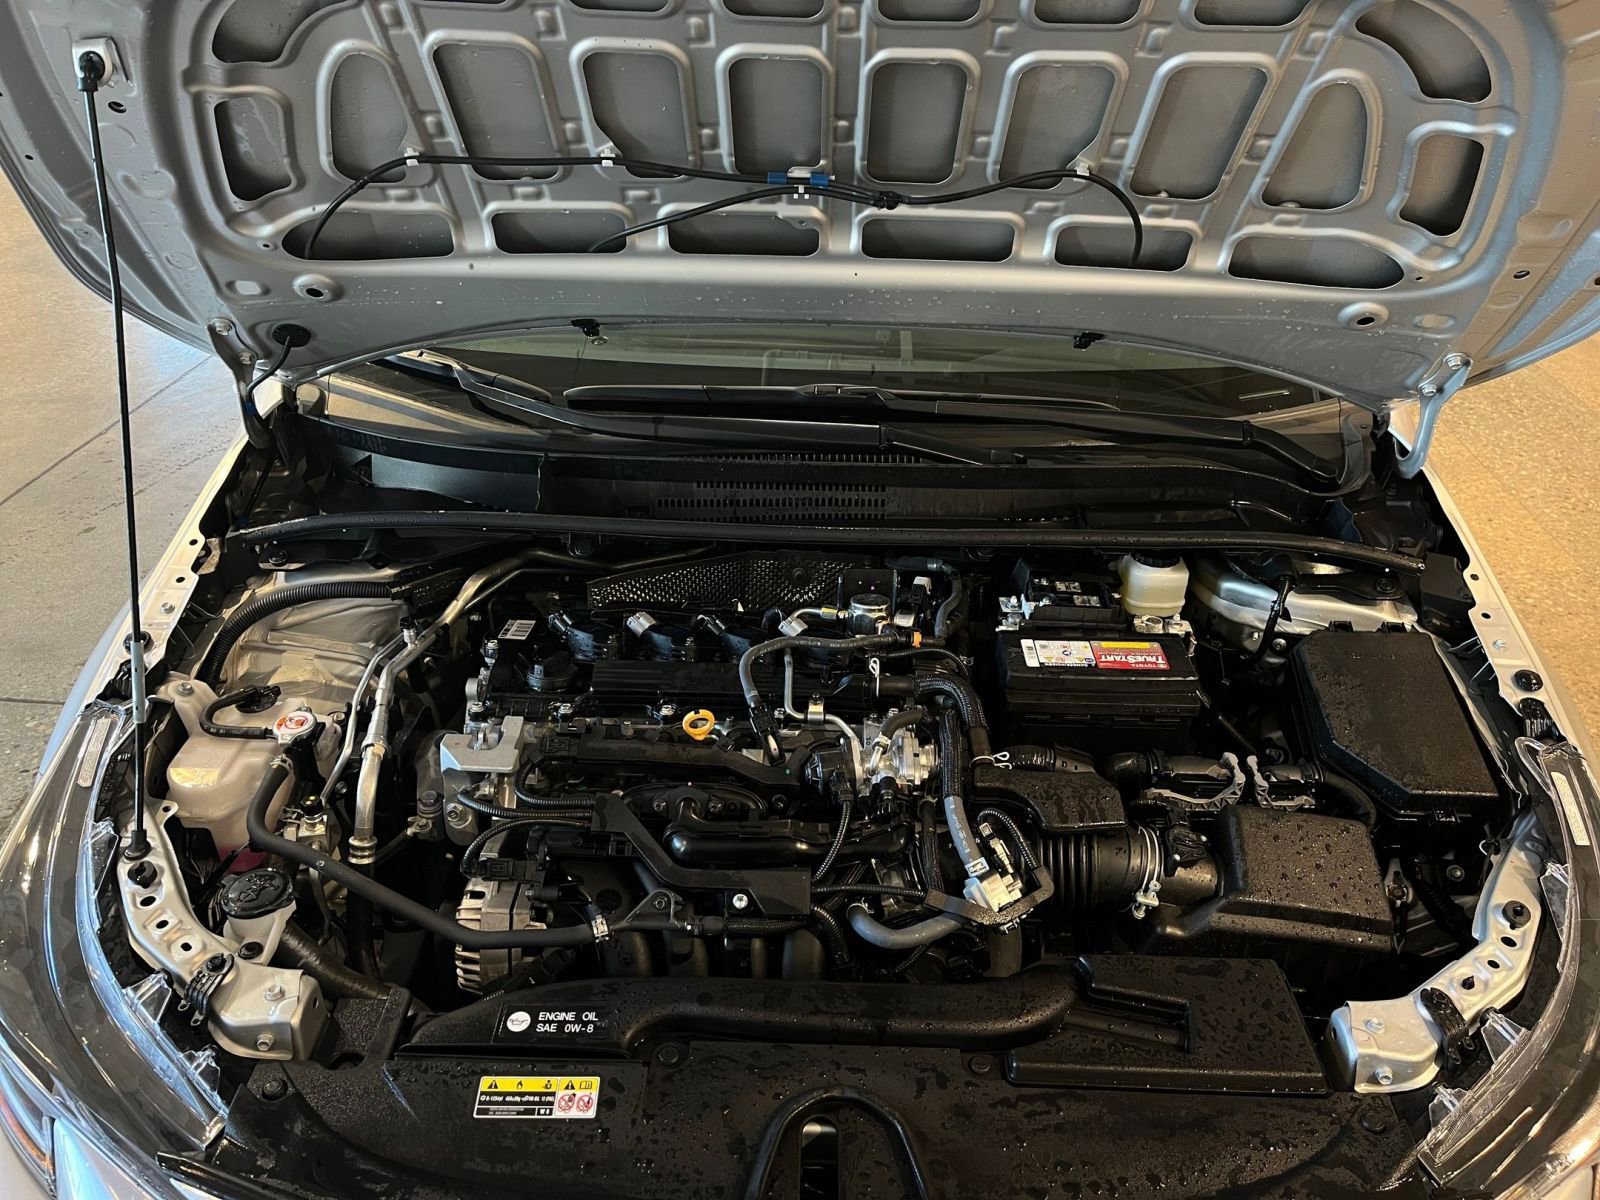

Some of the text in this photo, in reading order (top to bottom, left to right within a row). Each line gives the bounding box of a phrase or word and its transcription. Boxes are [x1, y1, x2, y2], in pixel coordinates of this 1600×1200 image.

[538, 1012, 599, 1021] ENGINE OIL
[536, 1023, 594, 1033] SAE 0W-8
